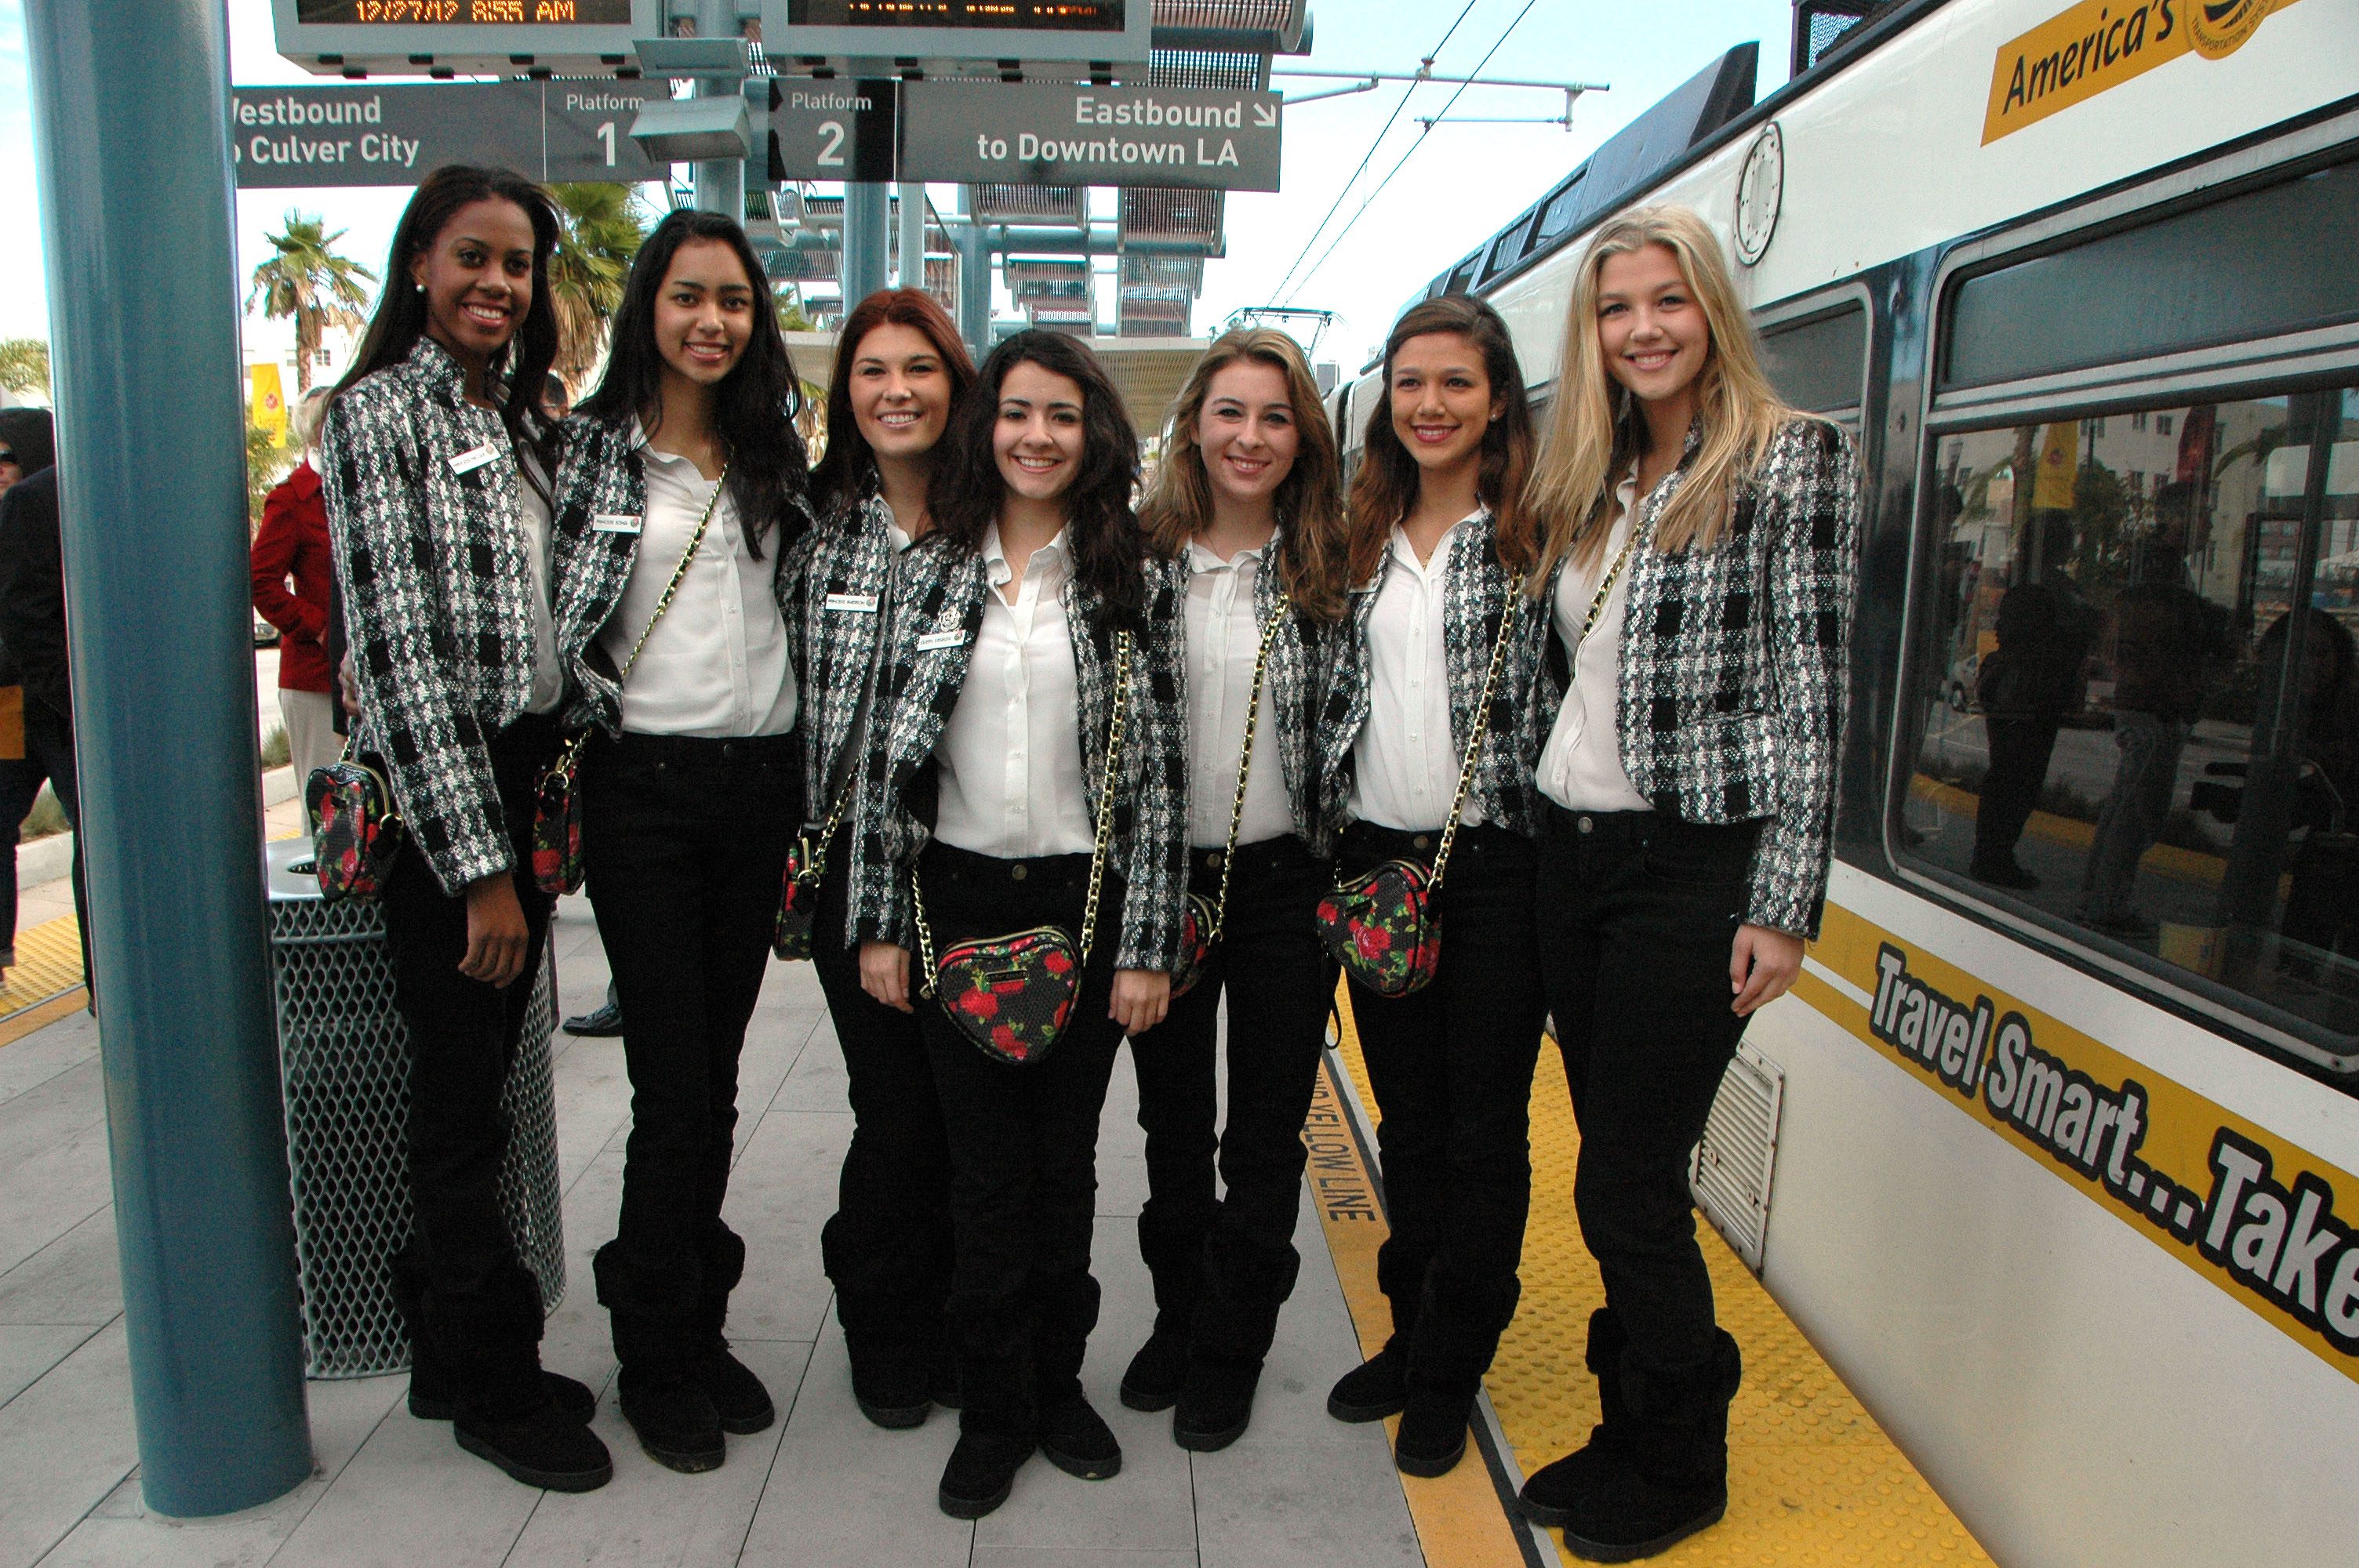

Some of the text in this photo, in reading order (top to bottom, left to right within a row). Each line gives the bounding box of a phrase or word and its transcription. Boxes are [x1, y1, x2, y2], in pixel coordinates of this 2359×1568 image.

[536, 0, 575, 22] AM
[233, 96, 381, 126] estbound
[566, 93, 645, 111] Platform
[792, 92, 873, 111] Platform
[1075, 96, 1242, 128] Eastbound
[251, 135, 352, 165] Culver
[360, 132, 420, 167] City
[597, 122, 616, 167] 1
[817, 120, 845, 166] 2
[977, 133, 1239, 166] to Downtown LA
[1871, 946, 1993, 1093] Travel
[2202, 1135, 2359, 1342] Take
[1303, 1103, 1376, 1221] YELLOW LINE
